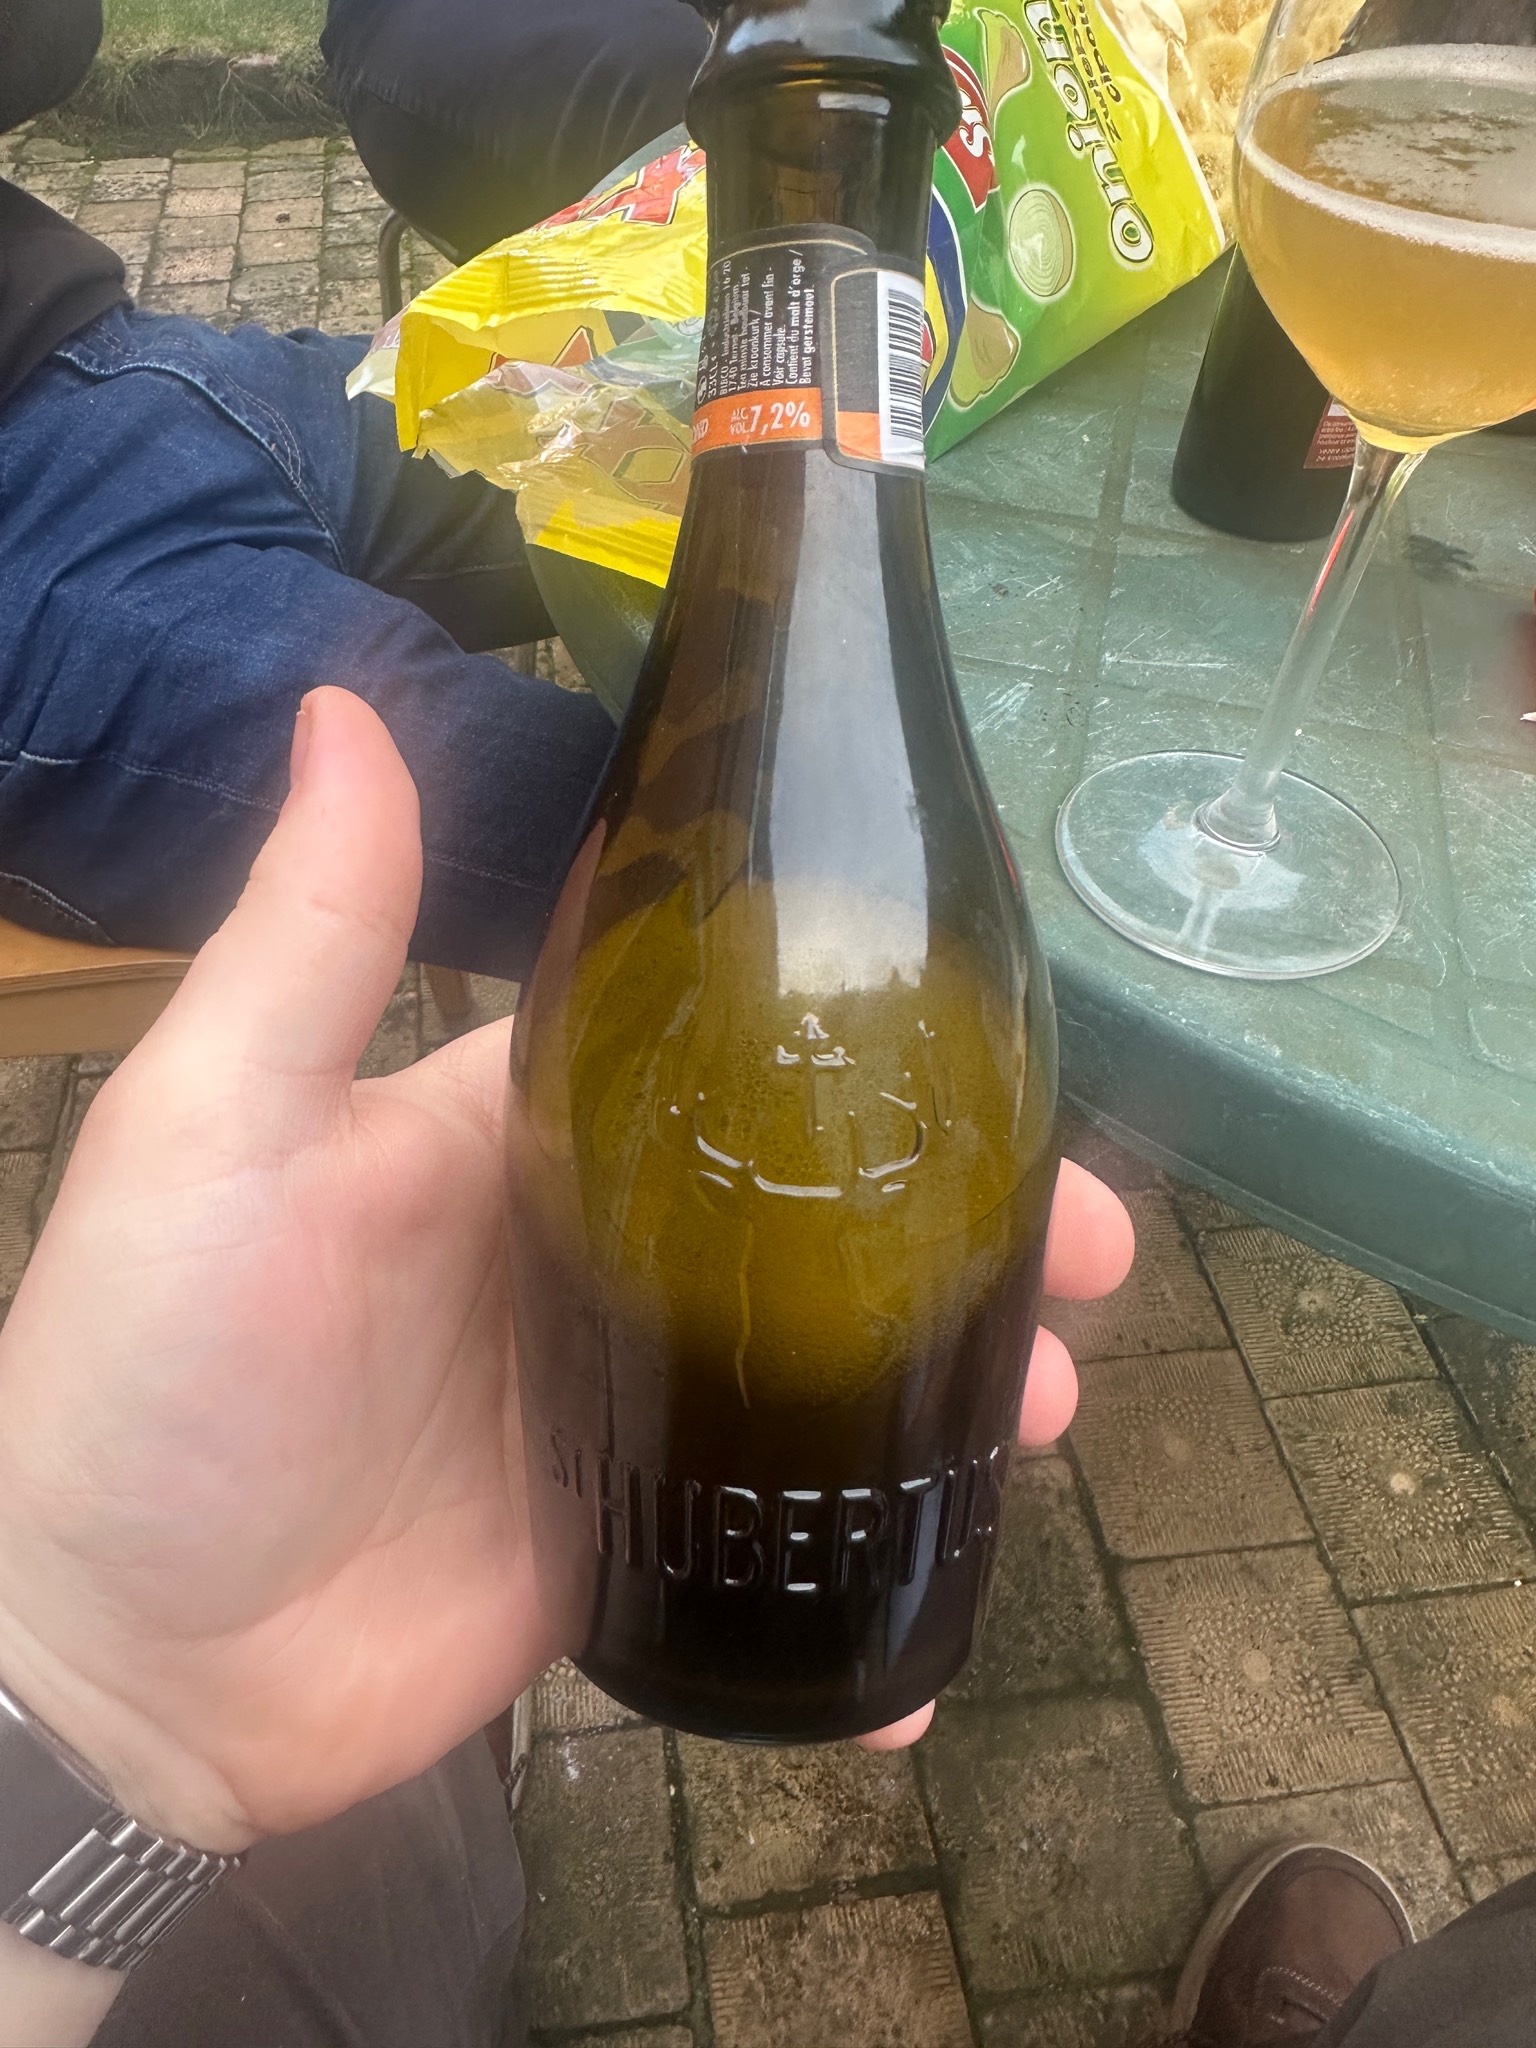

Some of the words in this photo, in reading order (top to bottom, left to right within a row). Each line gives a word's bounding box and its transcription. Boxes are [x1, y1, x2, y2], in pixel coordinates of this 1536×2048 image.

[1062, 0, 1122, 143] Zwiebe
[787, 301, 801, 327] malt
[763, 321, 773, 378] consommer
[786, 329, 800, 343] du
[772, 365, 785, 387] Voir
[785, 345, 799, 385] Contient
[799, 356, 812, 385] Bevat
[747, 373, 758, 388] Zie
[750, 401, 811, 435] 7,2%
